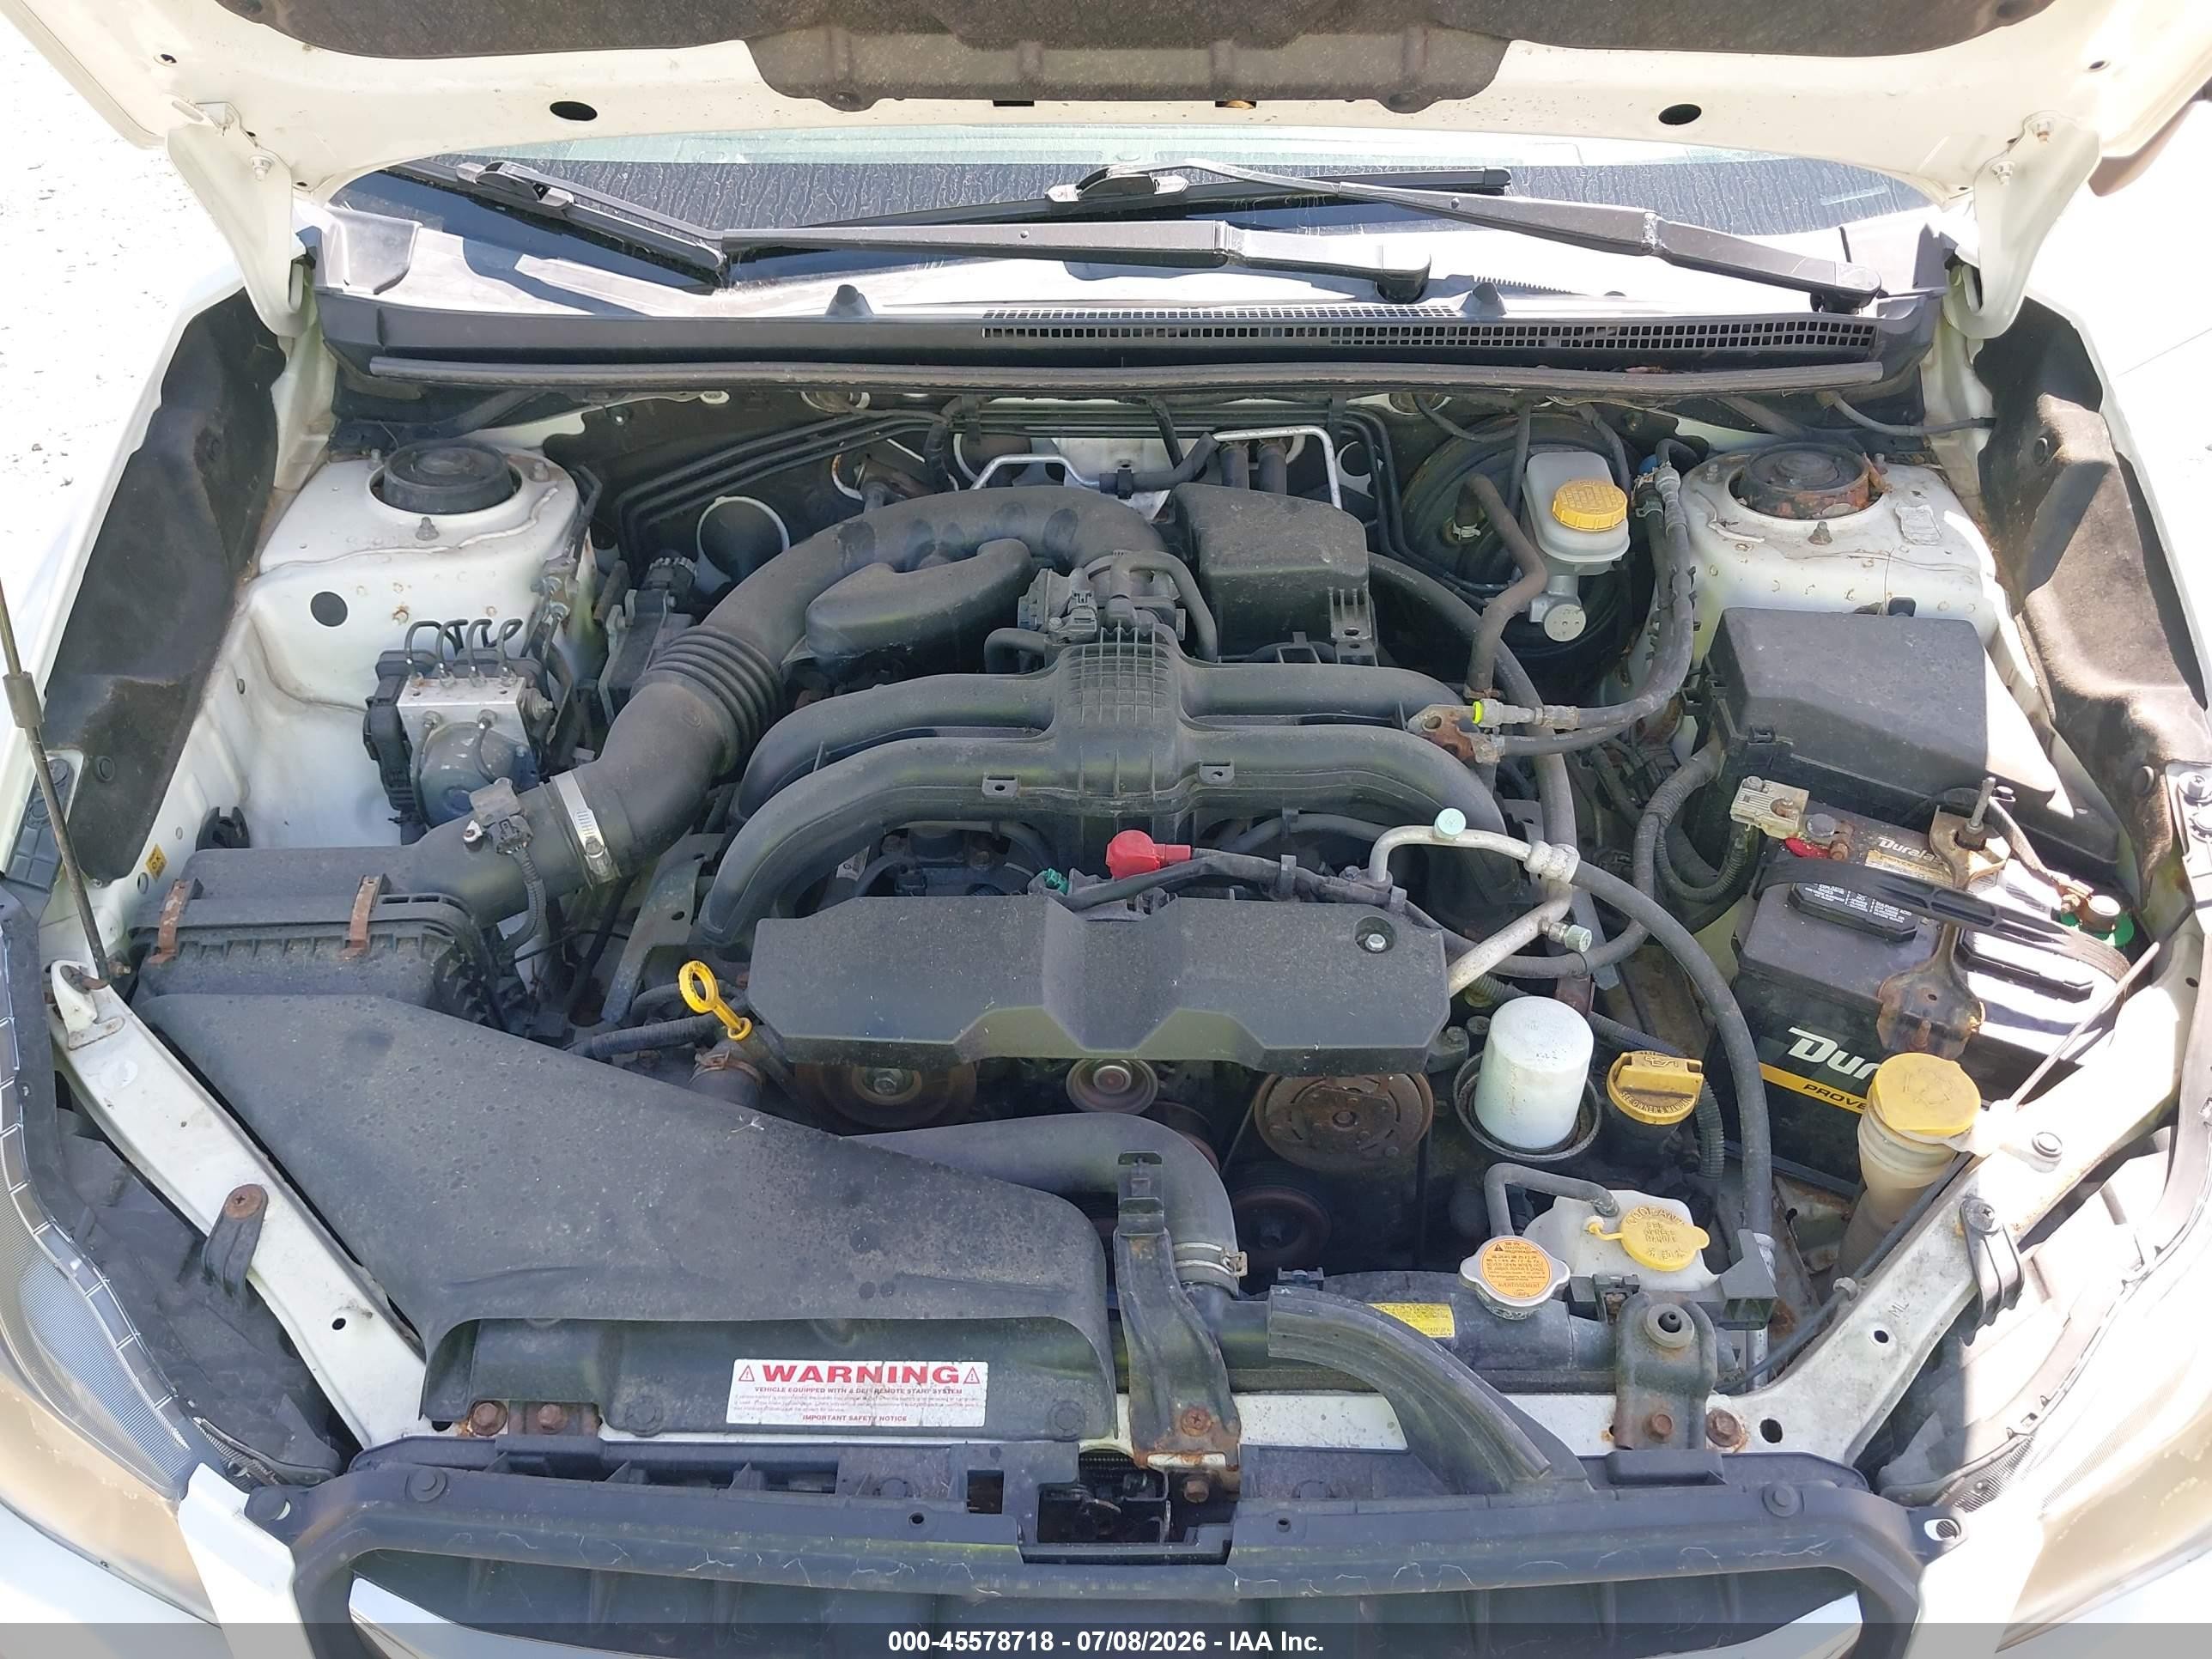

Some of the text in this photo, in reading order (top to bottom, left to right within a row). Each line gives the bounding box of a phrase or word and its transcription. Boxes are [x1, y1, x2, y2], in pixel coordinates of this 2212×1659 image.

[1620, 1091, 1634, 1103] SEE
[1632, 1100, 1664, 1114] OWNER'S
[763, 1364, 959, 1385] WARNING
